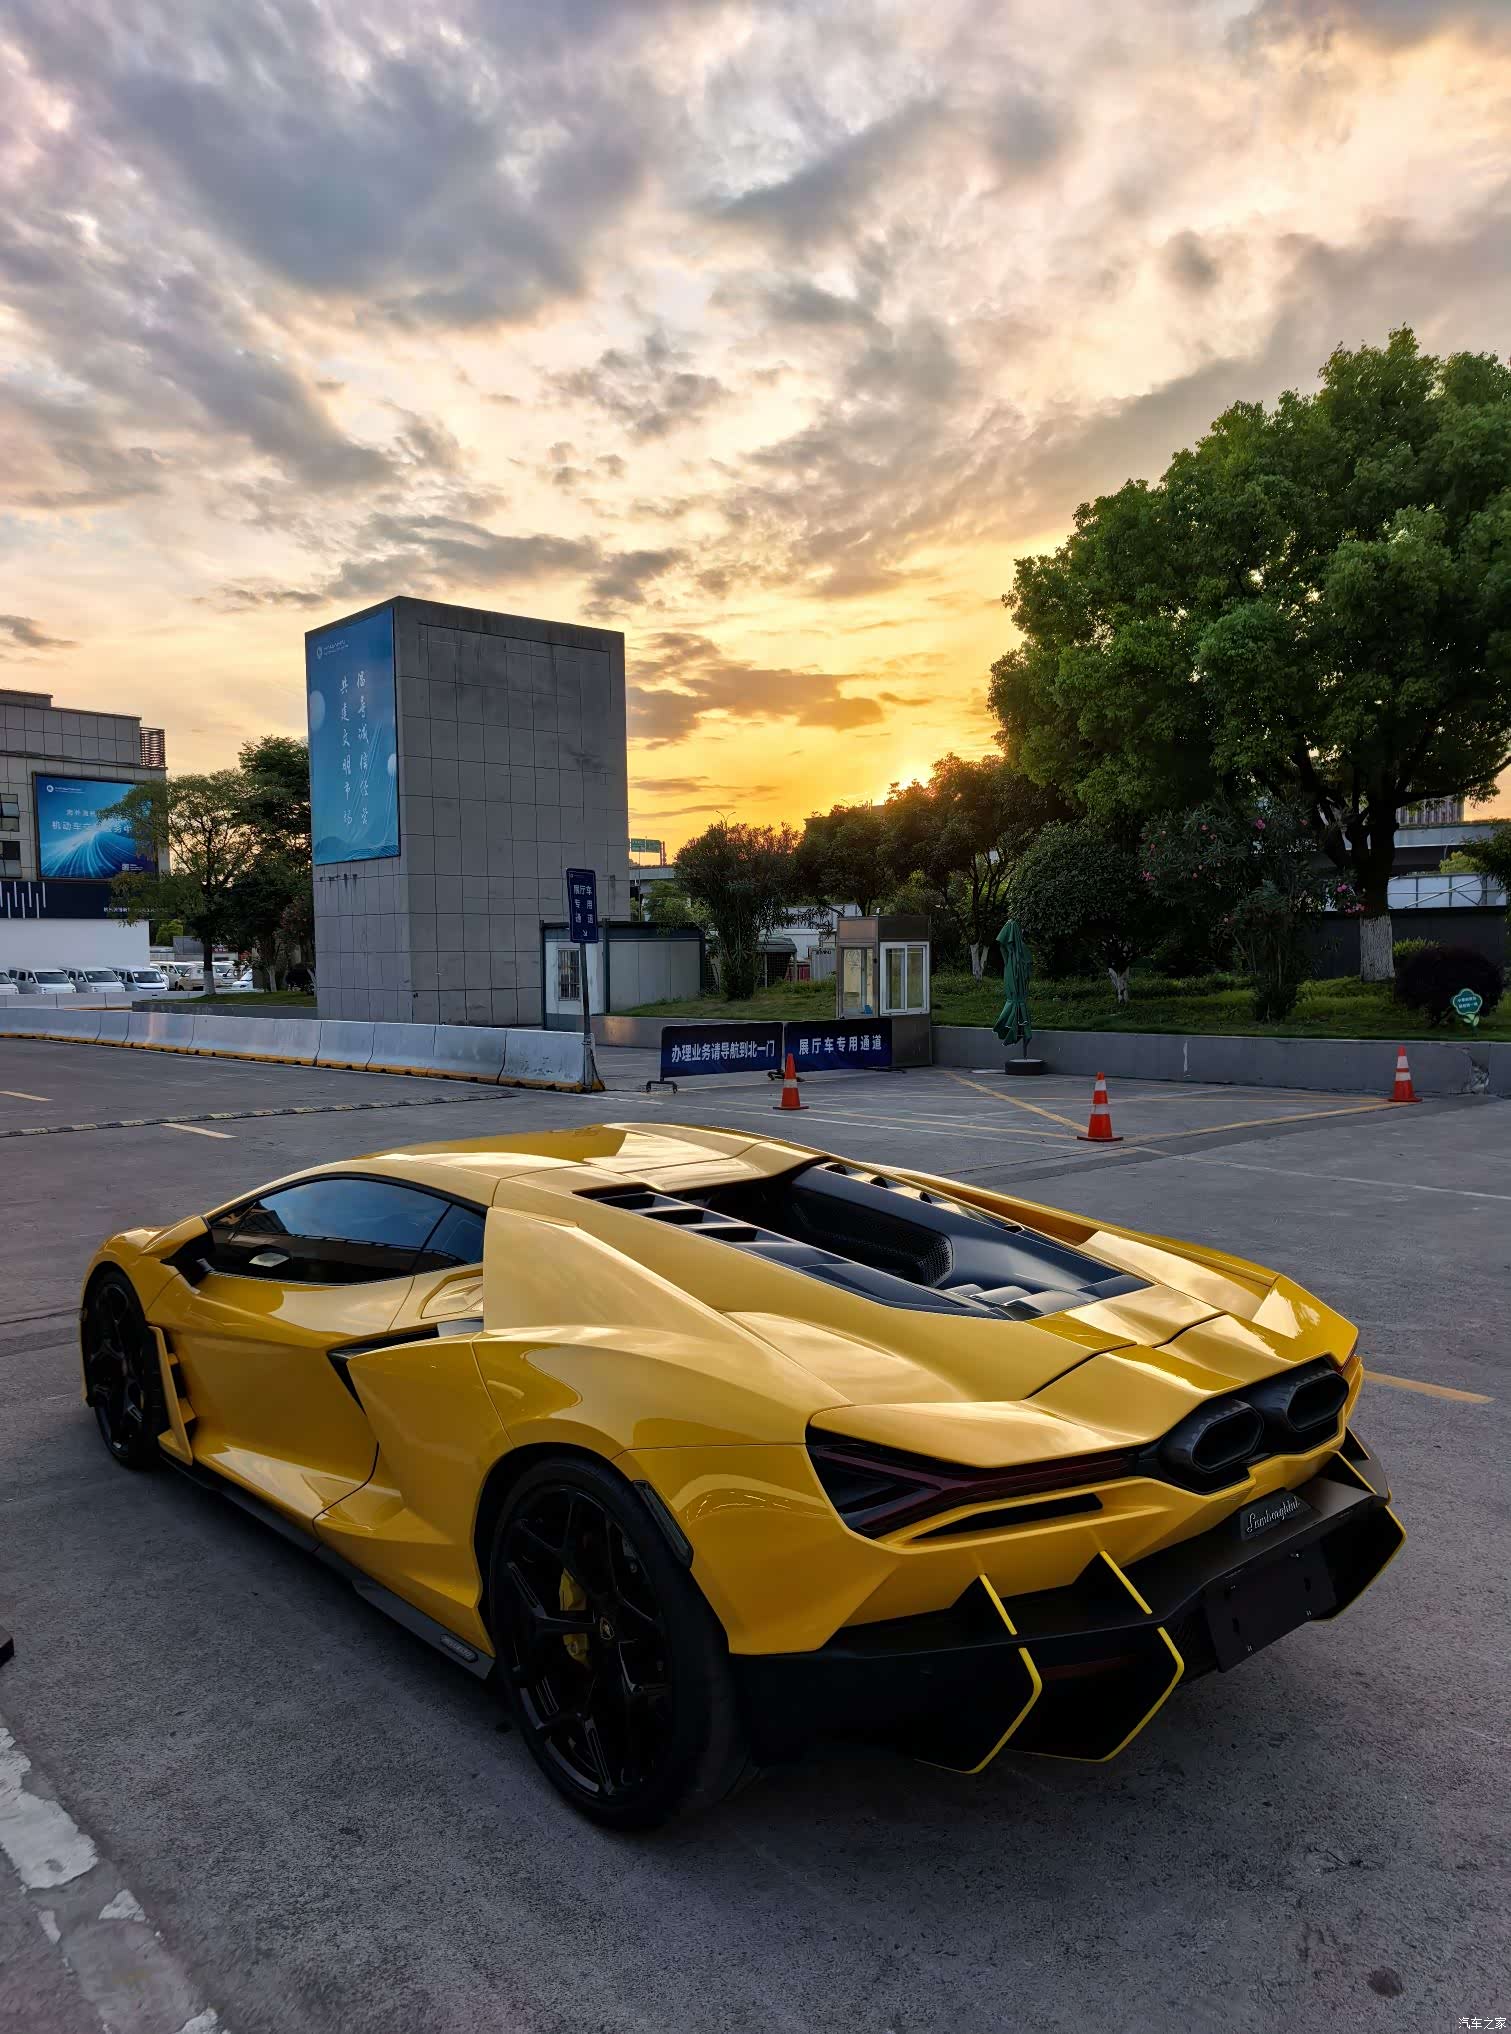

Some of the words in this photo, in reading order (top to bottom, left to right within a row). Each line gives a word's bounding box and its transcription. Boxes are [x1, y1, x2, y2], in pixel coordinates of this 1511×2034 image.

[671, 1039, 775, 1063] 办理业务请导航到北一门
[798, 1034, 883, 1056] 展厅车专用通道
